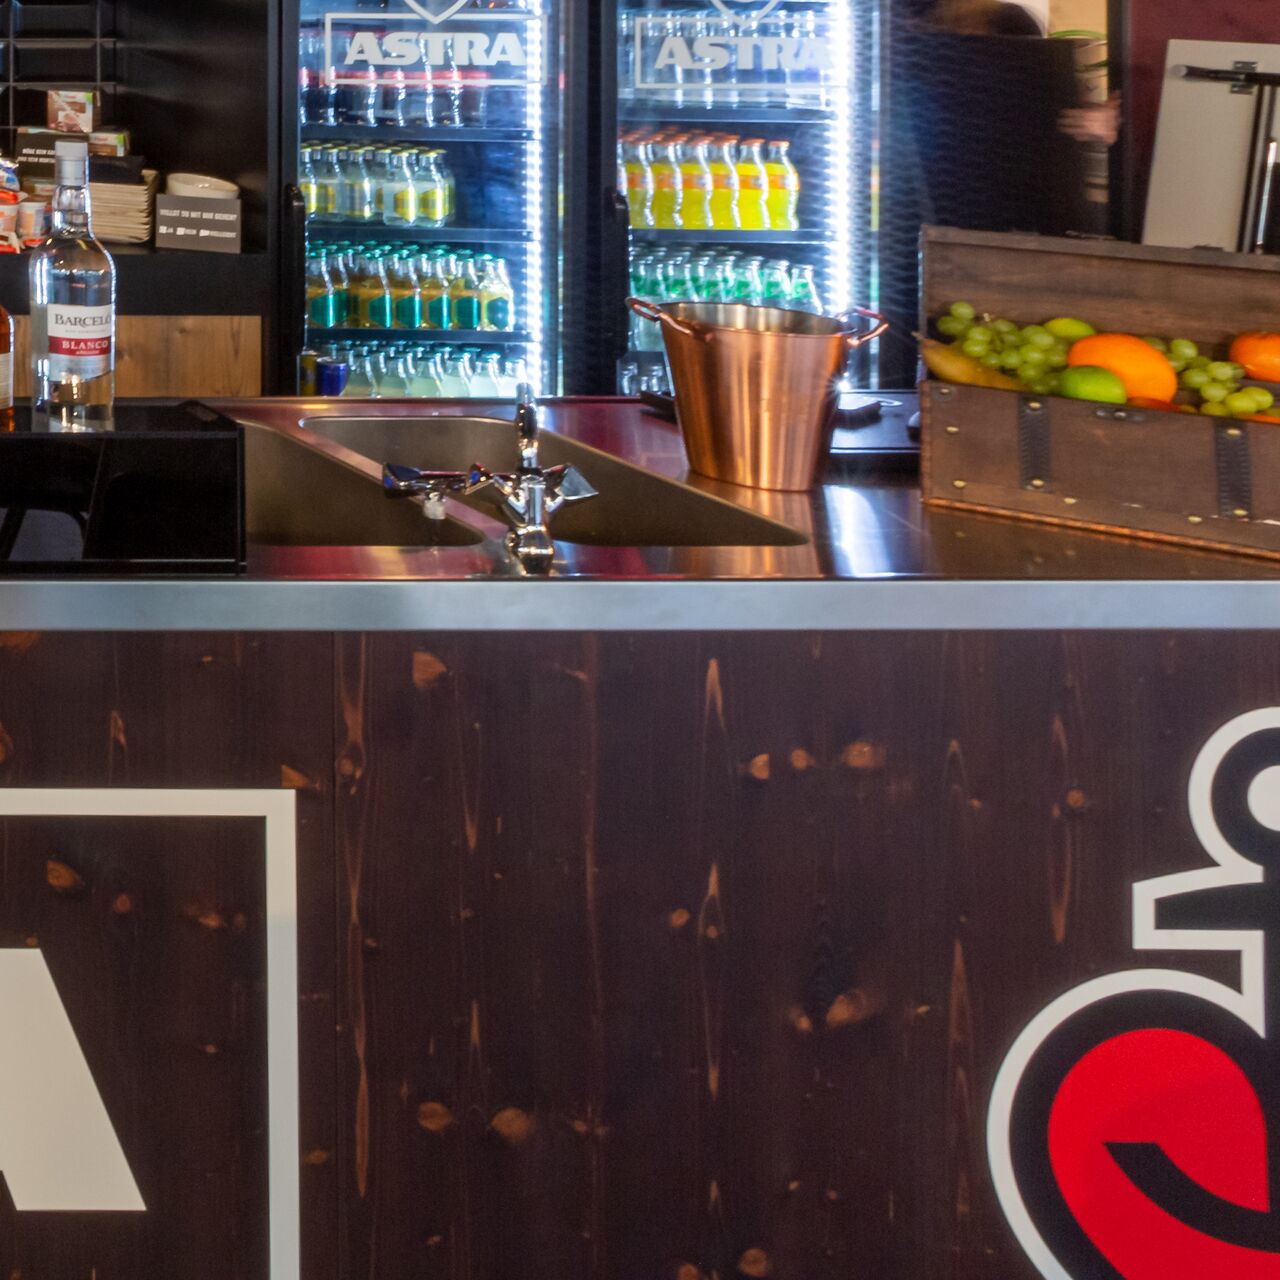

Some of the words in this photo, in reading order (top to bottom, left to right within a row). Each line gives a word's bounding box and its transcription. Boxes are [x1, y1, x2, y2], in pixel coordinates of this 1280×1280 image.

[344, 31, 528, 66] ASTRA
[654, 36, 836, 70] ASTRA
[62, 340, 109, 351] BLANCO
